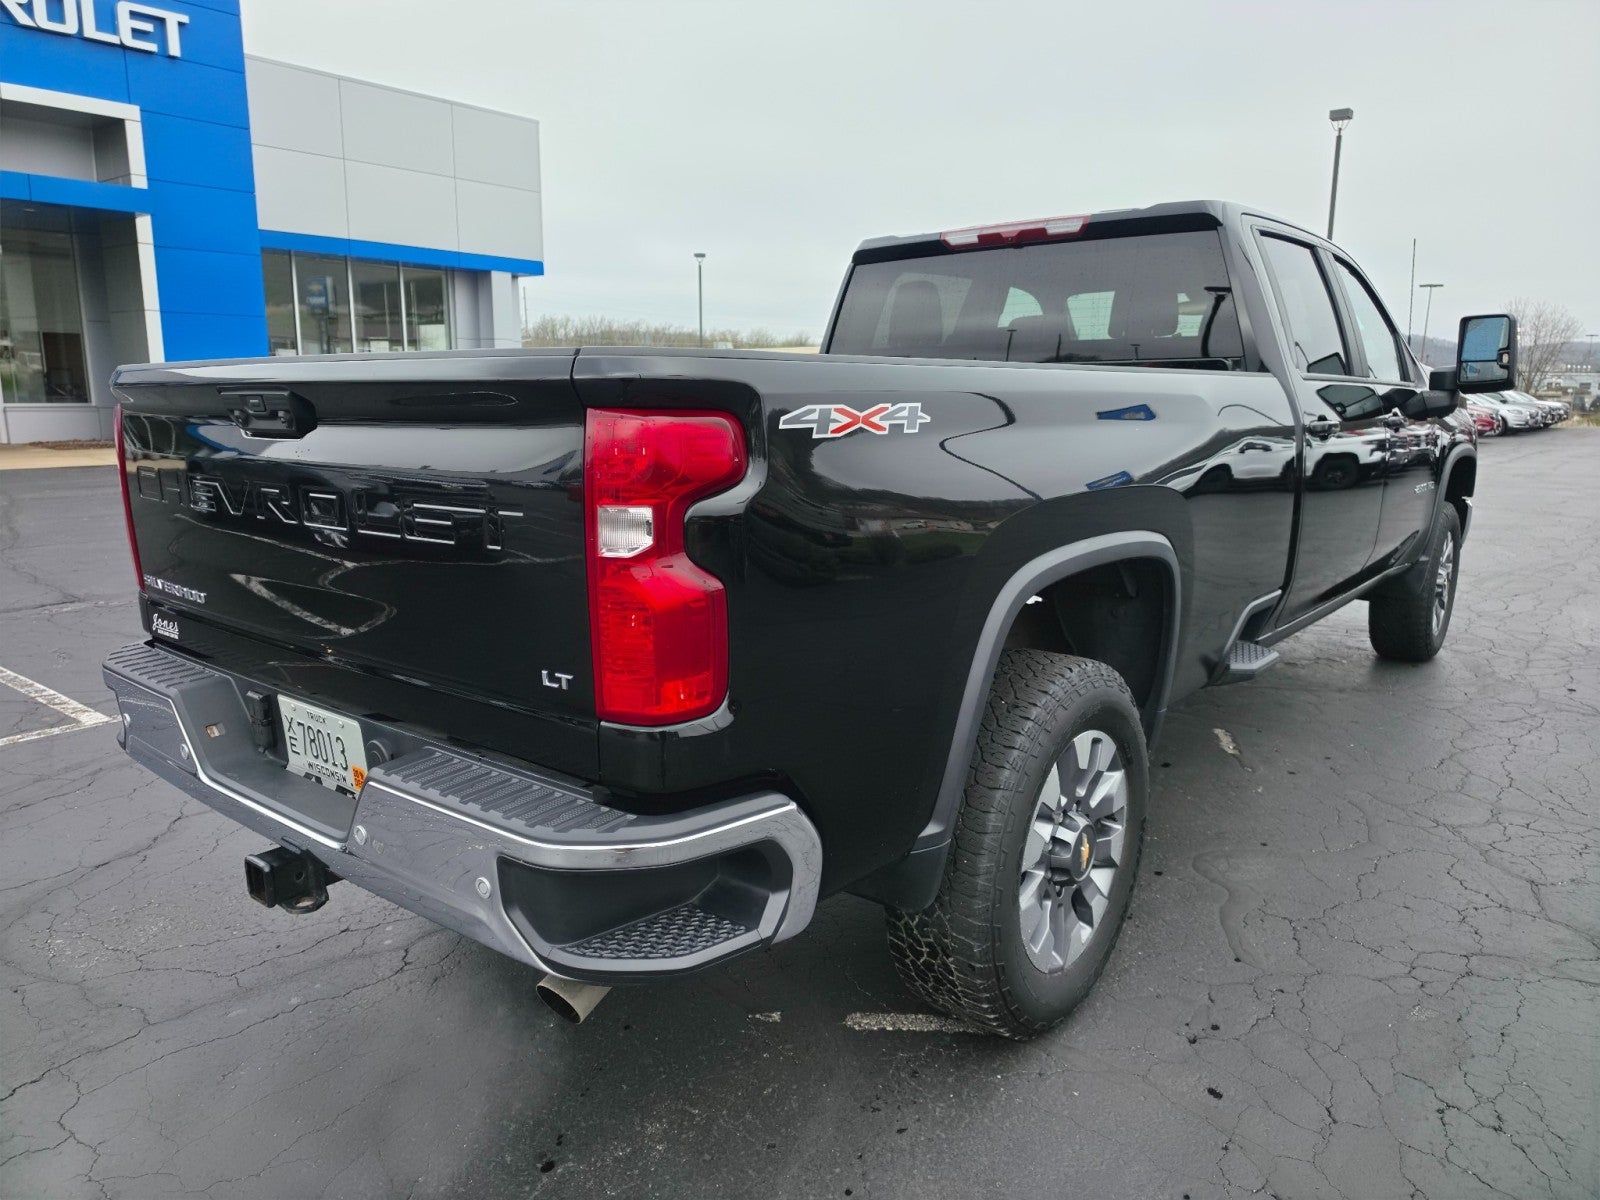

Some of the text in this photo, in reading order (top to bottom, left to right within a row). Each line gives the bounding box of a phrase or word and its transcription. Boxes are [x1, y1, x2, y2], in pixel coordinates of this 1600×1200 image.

[779, 402, 931, 438] 4X4
[136, 465, 524, 549] CHEVROLET
[152, 613, 179, 632] Jones
[541, 670, 574, 690] LT
[306, 711, 326, 724] TRUCK
[297, 719, 349, 772] 78013
[307, 761, 347, 784] WISCONSIN
